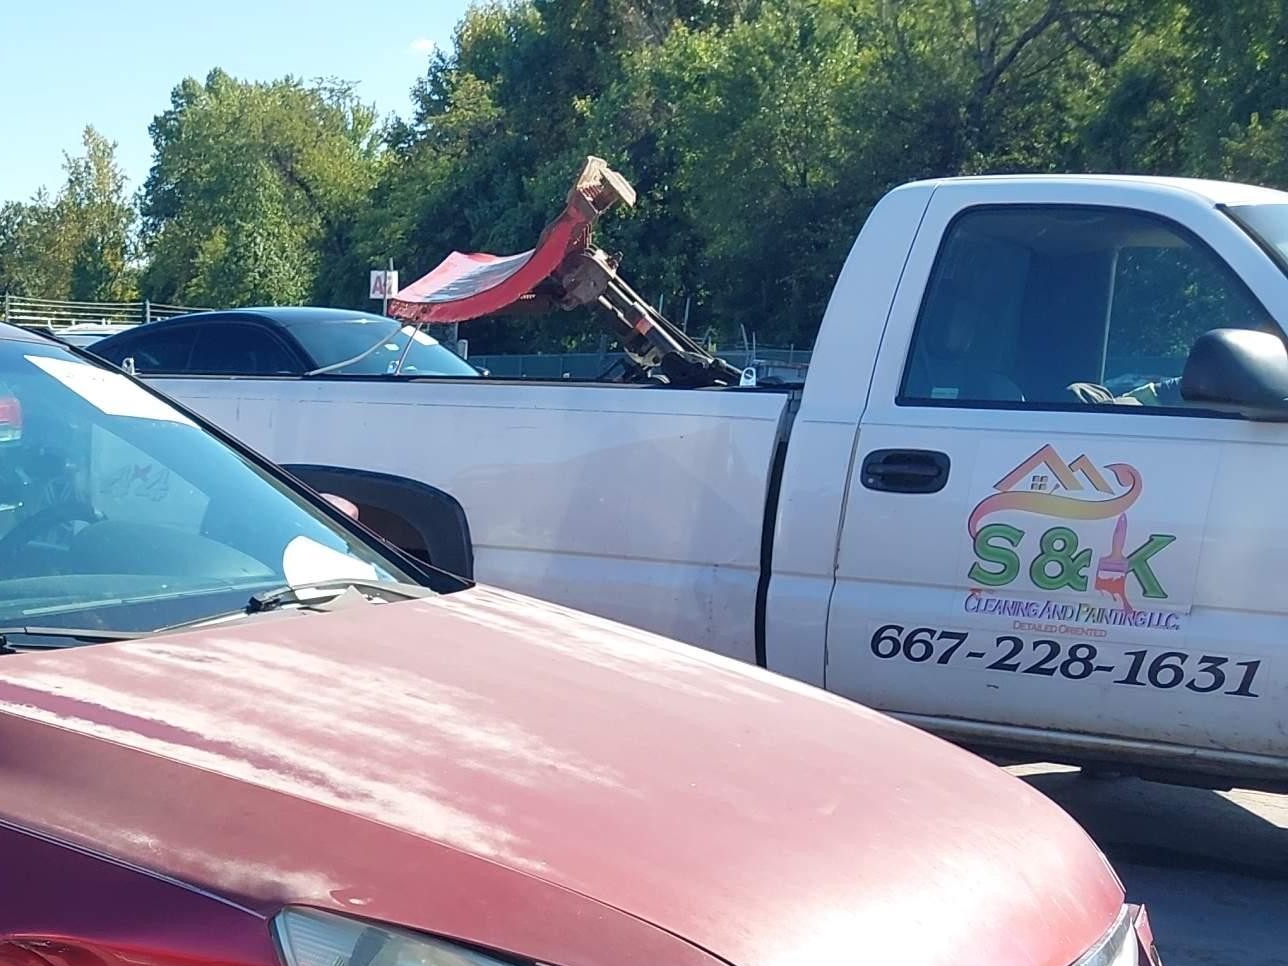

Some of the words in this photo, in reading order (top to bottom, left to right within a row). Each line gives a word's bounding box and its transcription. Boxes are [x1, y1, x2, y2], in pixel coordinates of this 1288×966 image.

[964, 592, 1038, 618] CLEANING
[1037, 600, 1075, 620] AND
[1074, 602, 1146, 628] PAINTING
[1013, 620, 1058, 633] DETAILED
[870, 624, 1261, 698] 667-228-1631
